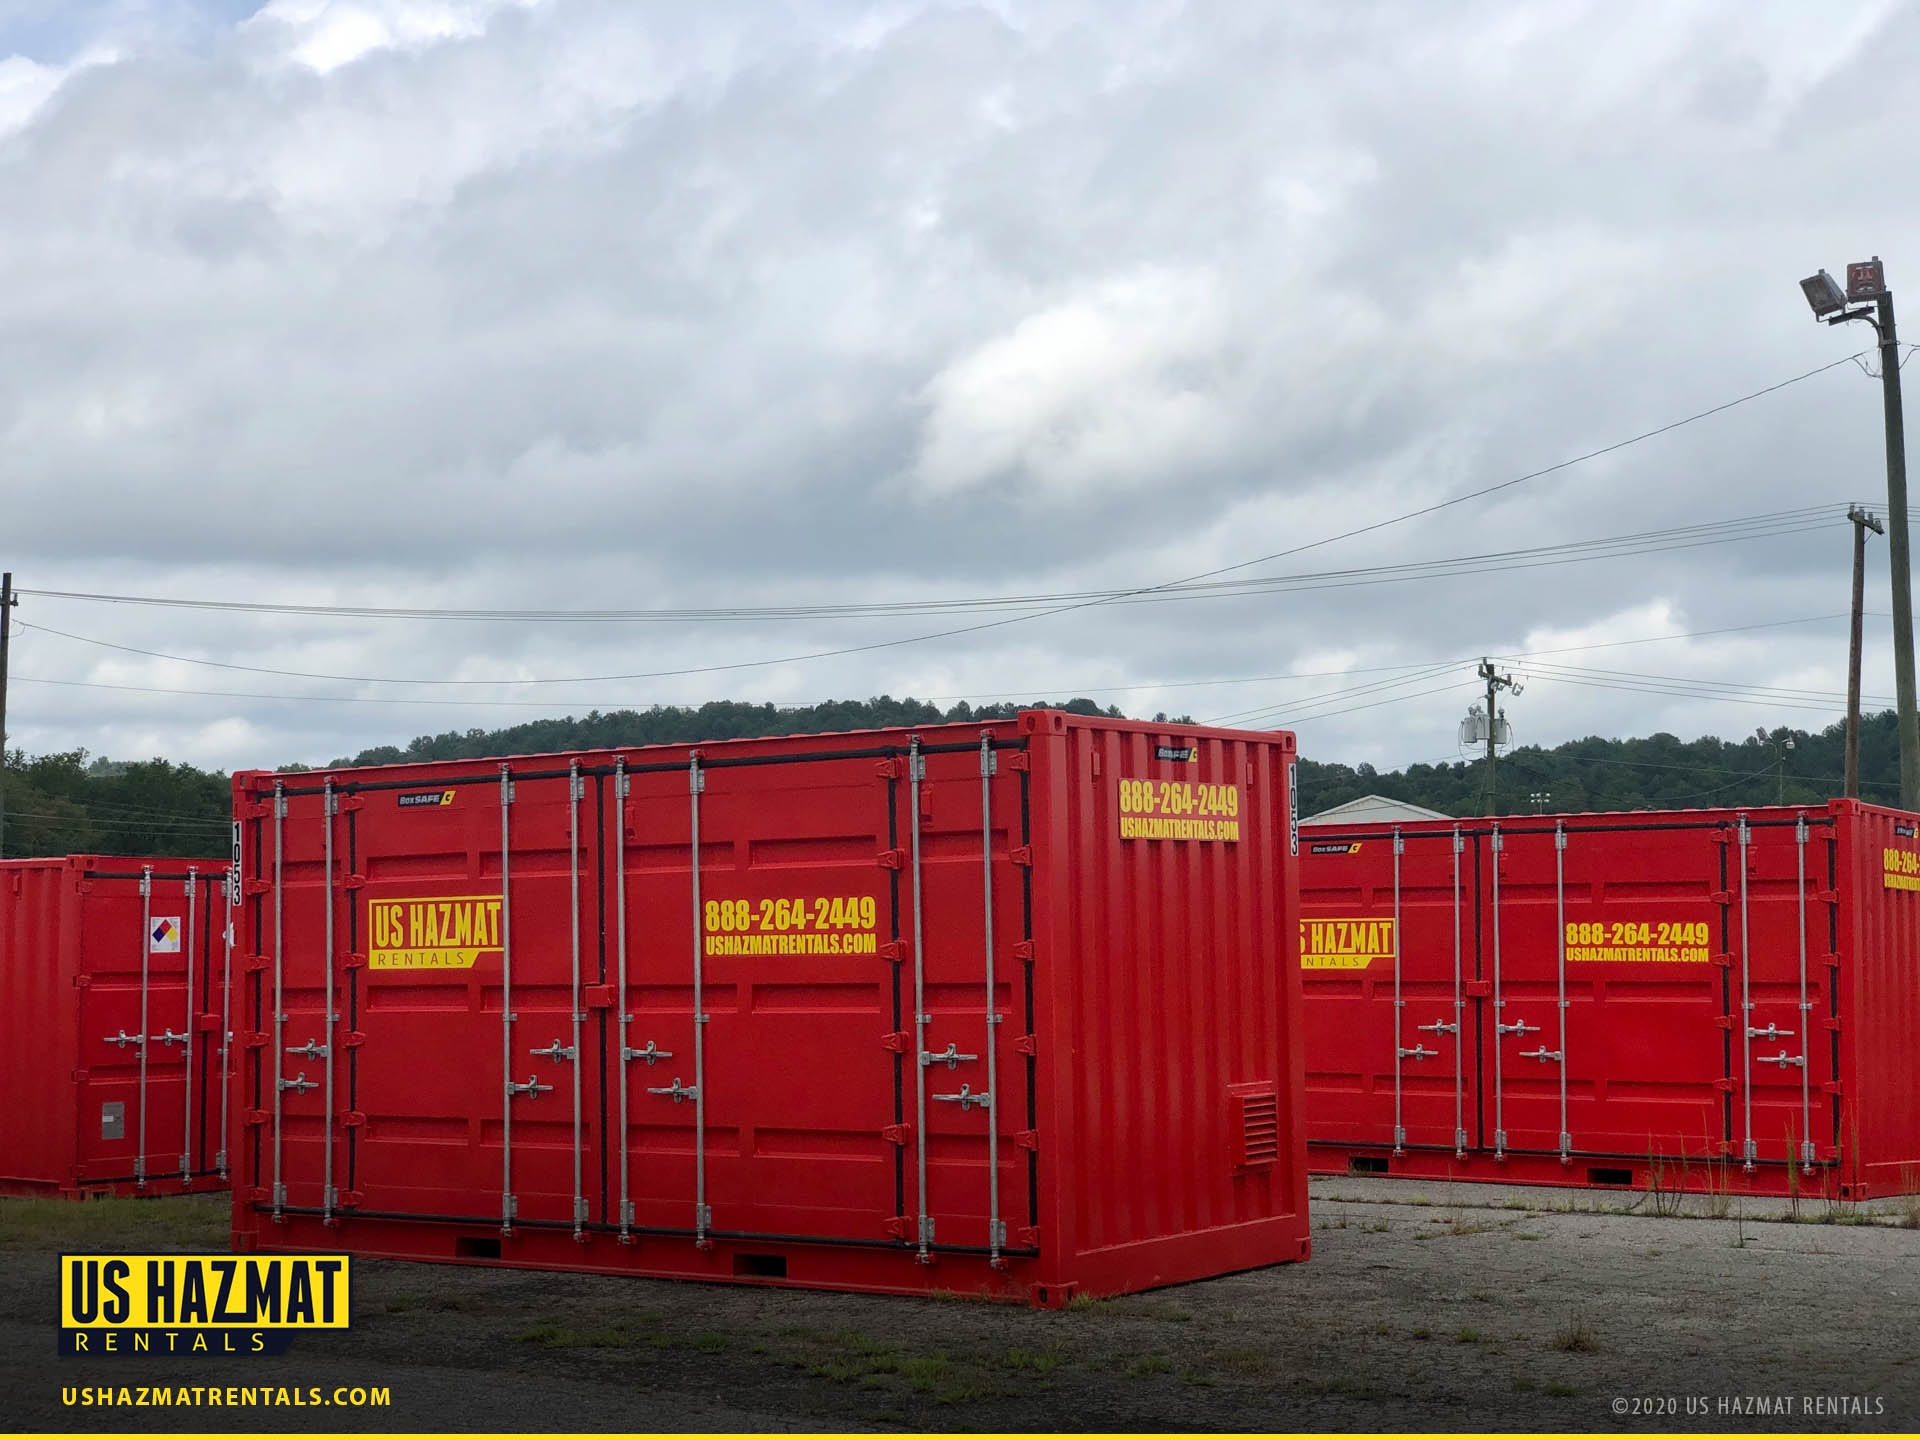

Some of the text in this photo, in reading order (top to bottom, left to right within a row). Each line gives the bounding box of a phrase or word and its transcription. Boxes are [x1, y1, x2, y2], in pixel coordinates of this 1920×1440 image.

[1120, 779, 1238, 817] 888-264-2449
[1290, 764, 1298, 855] 1053
[1120, 816, 1239, 841] USHAZMATRENTALS.COM
[233, 822, 241, 905] 1053
[375, 901, 501, 948] US HAZMAT
[705, 896, 876, 932] 888-264-2449
[705, 933, 877, 956] USHAZMATRENTALS.COM
[1311, 922, 1392, 954] HAZMAT
[1565, 922, 1709, 945] 888-264-2449
[378, 951, 465, 966] RENTALS
[1566, 947, 1710, 963] USHAZMATRENTALS.COM
